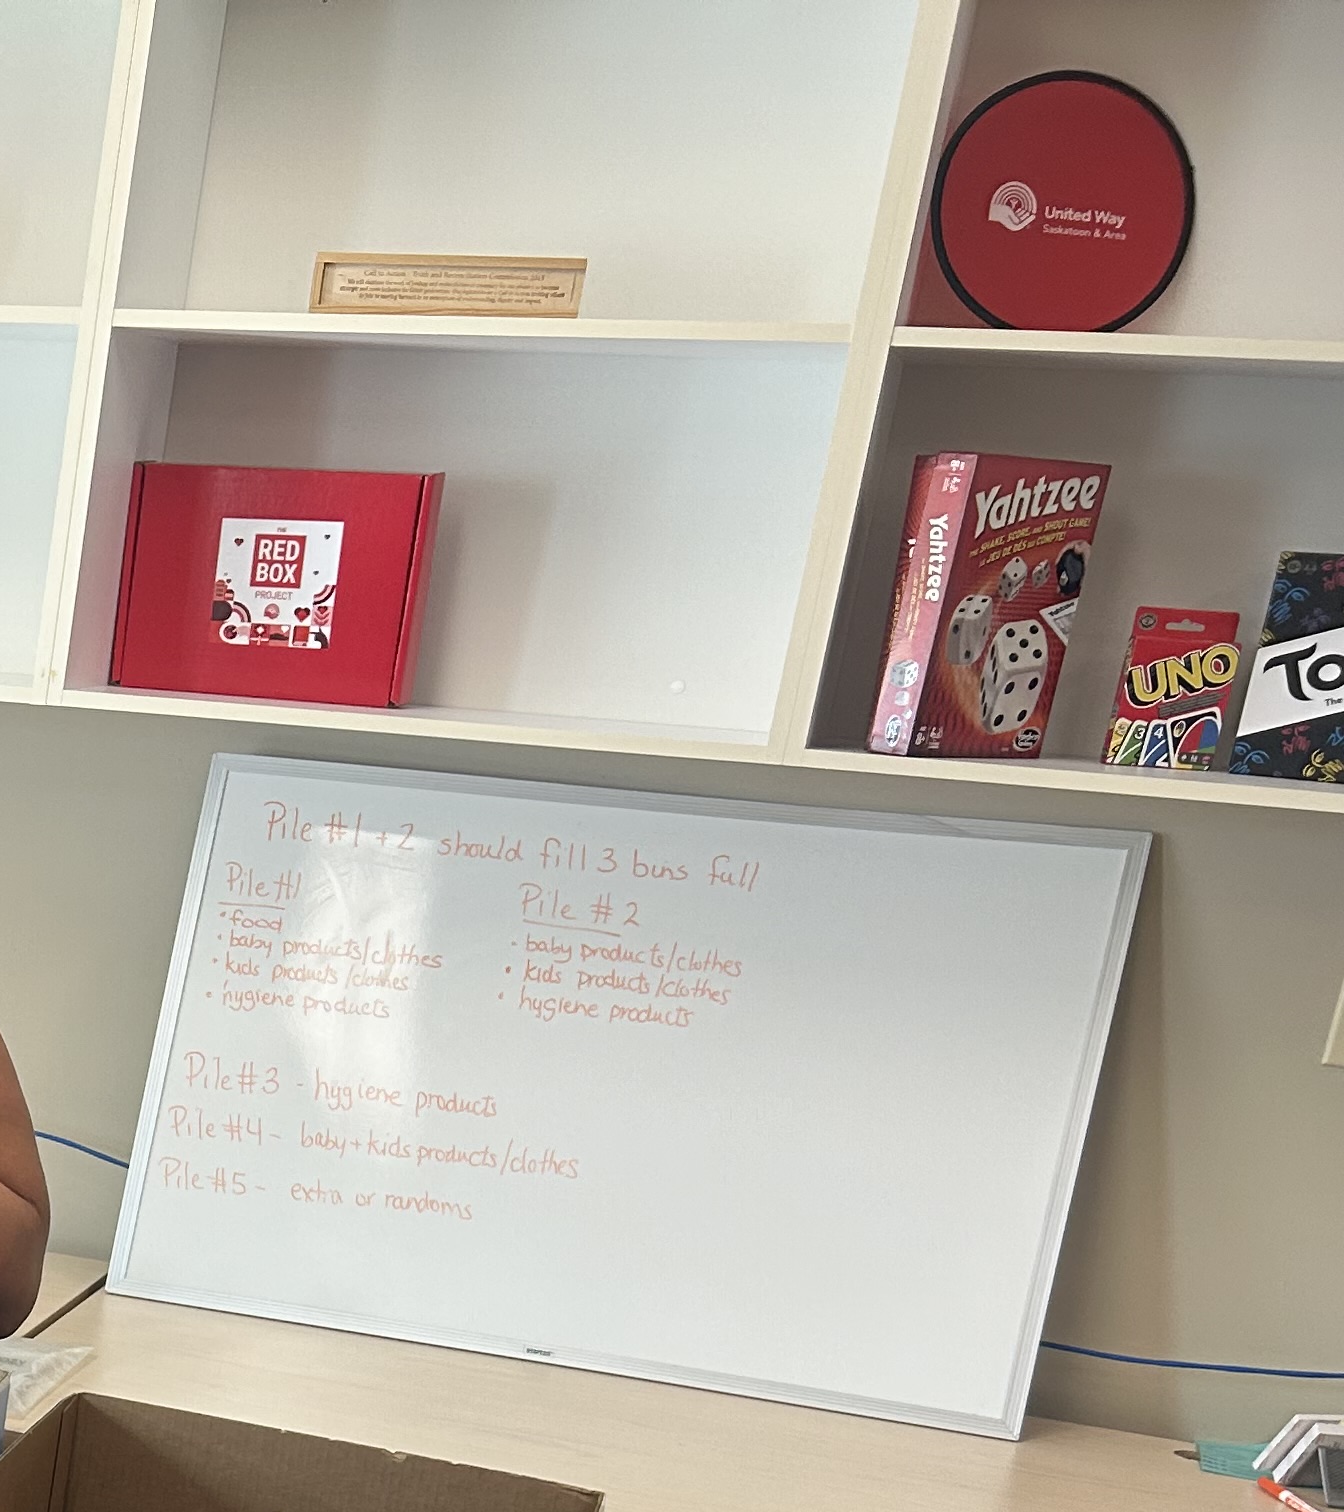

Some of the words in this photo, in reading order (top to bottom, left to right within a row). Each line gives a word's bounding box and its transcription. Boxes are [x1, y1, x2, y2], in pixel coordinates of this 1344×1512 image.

[1044, 205, 1091, 222] United
[1095, 210, 1127, 229] Way
[1042, 224, 1092, 237] Saskatoon
[1093, 228, 1101, 238] &
[1103, 230, 1127, 241] Area
[974, 474, 1101, 540] Yahtzee
[1043, 518, 1069, 531] SHOUT
[258, 538, 300, 561] RED
[924, 513, 949, 602] Yahtzee
[255, 562, 298, 584] BOX
[254, 590, 294, 601] PROJECT
[1127, 643, 1240, 707] UNO
[1134, 727, 1144, 739] 3
[1153, 726, 1164, 739] 4
[264, 801, 312, 842] Pile
[324, 811, 362, 848] #1
[397, 823, 415, 851] 2
[437, 829, 523, 862] should
[540, 837, 587, 870] fill
[596, 848, 618, 873] 3
[708, 854, 759, 892] full
[225, 861, 270, 898] Pile
[518, 882, 577, 920] Pile
[623, 901, 640, 927] 2
[229, 908, 283, 933] food
[229, 929, 273, 959] baby
[525, 933, 573, 964] baby
[225, 951, 260, 977] kids
[523, 959, 562, 984] kids
[223, 980, 295, 1012] hygiene
[303, 996, 390, 1019] products
[519, 985, 599, 1022] hygiene
[610, 1004, 694, 1028] products
[184, 1051, 232, 1092] Pile
[313, 1067, 402, 1112] hygiene
[415, 1090, 498, 1118] products
[167, 1105, 217, 1141] Pile
[416, 1138, 580, 1180] products/clothes
[158, 1156, 205, 1192] Pile
[290, 1177, 344, 1205] extra
[354, 1190, 376, 1209] or
[384, 1191, 473, 1222] randoms
